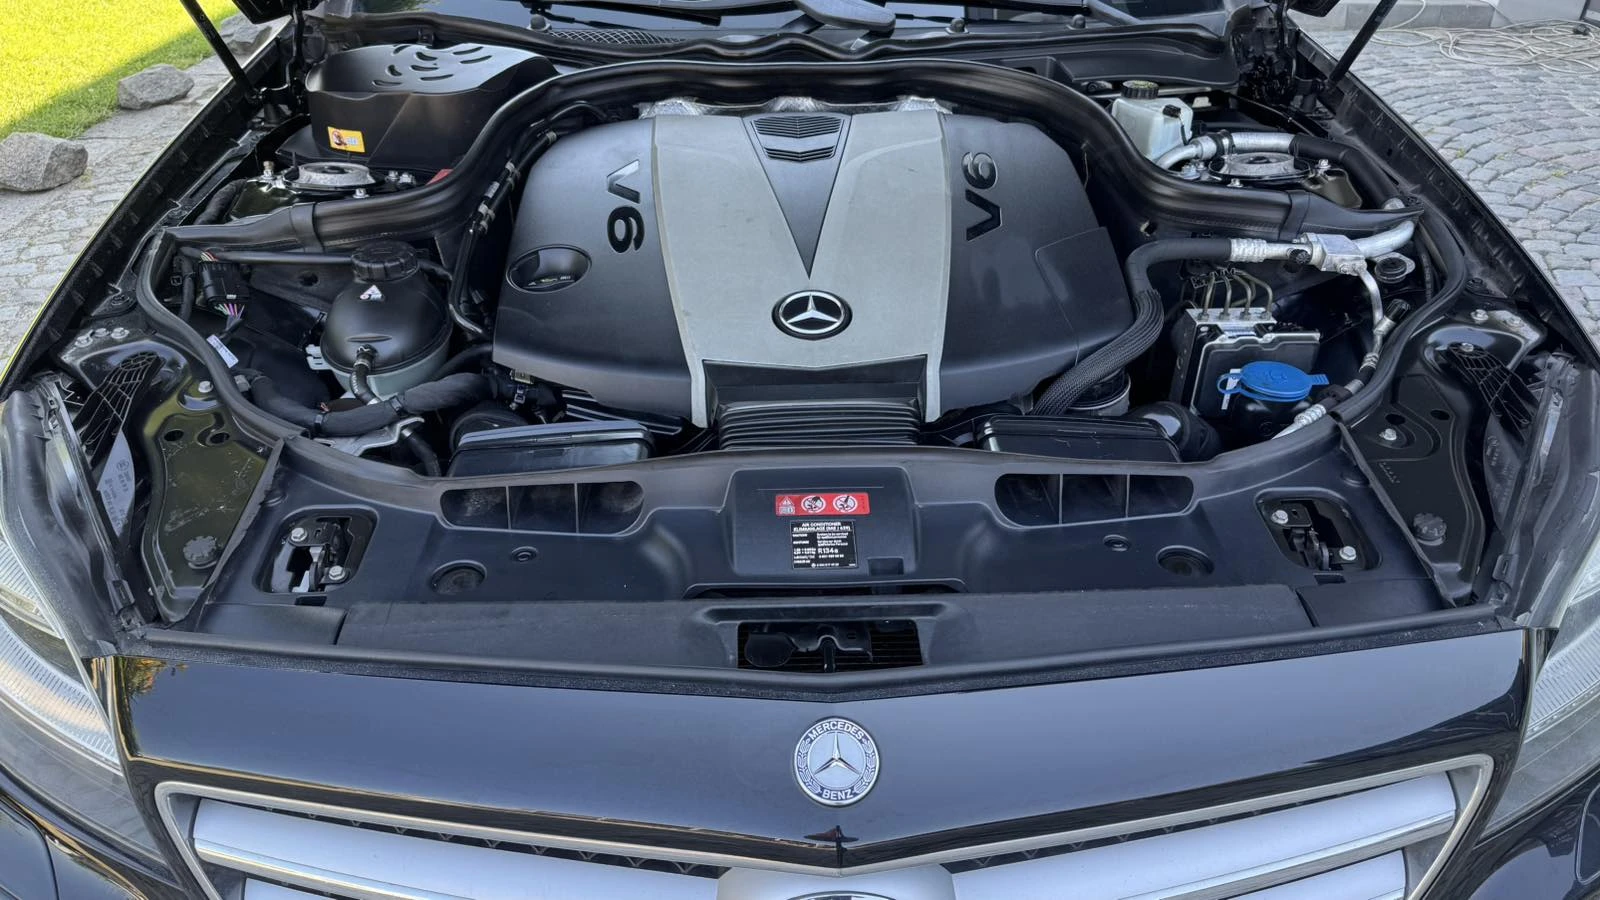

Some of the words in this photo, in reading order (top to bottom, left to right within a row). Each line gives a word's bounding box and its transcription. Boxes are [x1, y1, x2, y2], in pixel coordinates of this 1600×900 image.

[607, 159, 645, 253] V6
[961, 152, 1001, 241] V6
[808, 721, 865, 740] MERCEDES
[821, 788, 854, 800] BENZ
